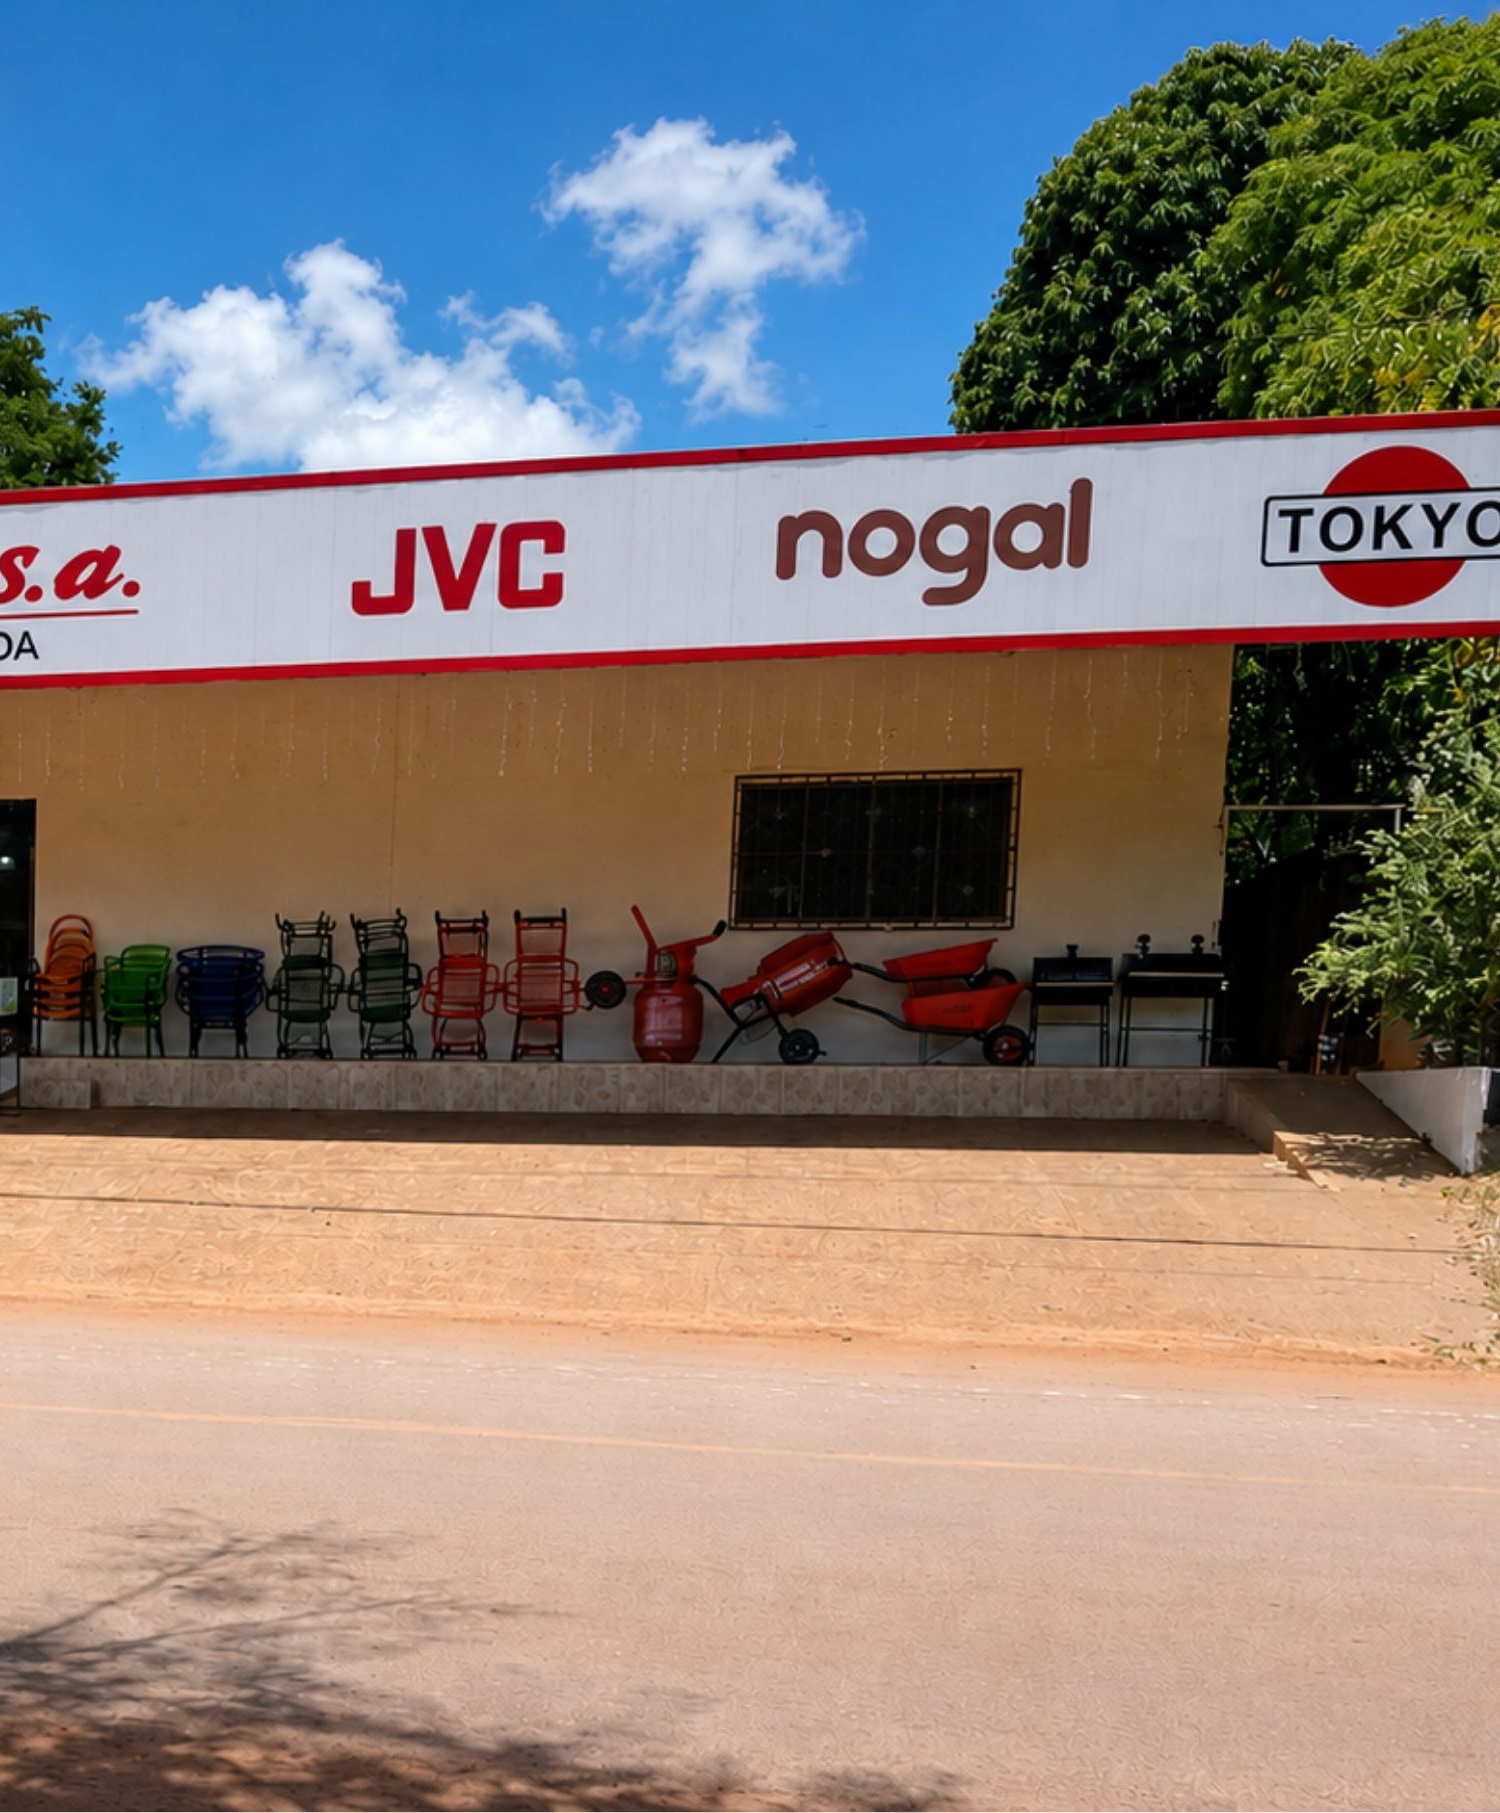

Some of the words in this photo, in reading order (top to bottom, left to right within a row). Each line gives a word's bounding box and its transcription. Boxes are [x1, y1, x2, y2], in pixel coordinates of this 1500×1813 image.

[351, 520, 566, 617] JVC
[775, 477, 1094, 607] nogal
[1277, 499, 1500, 554] TOKYO
